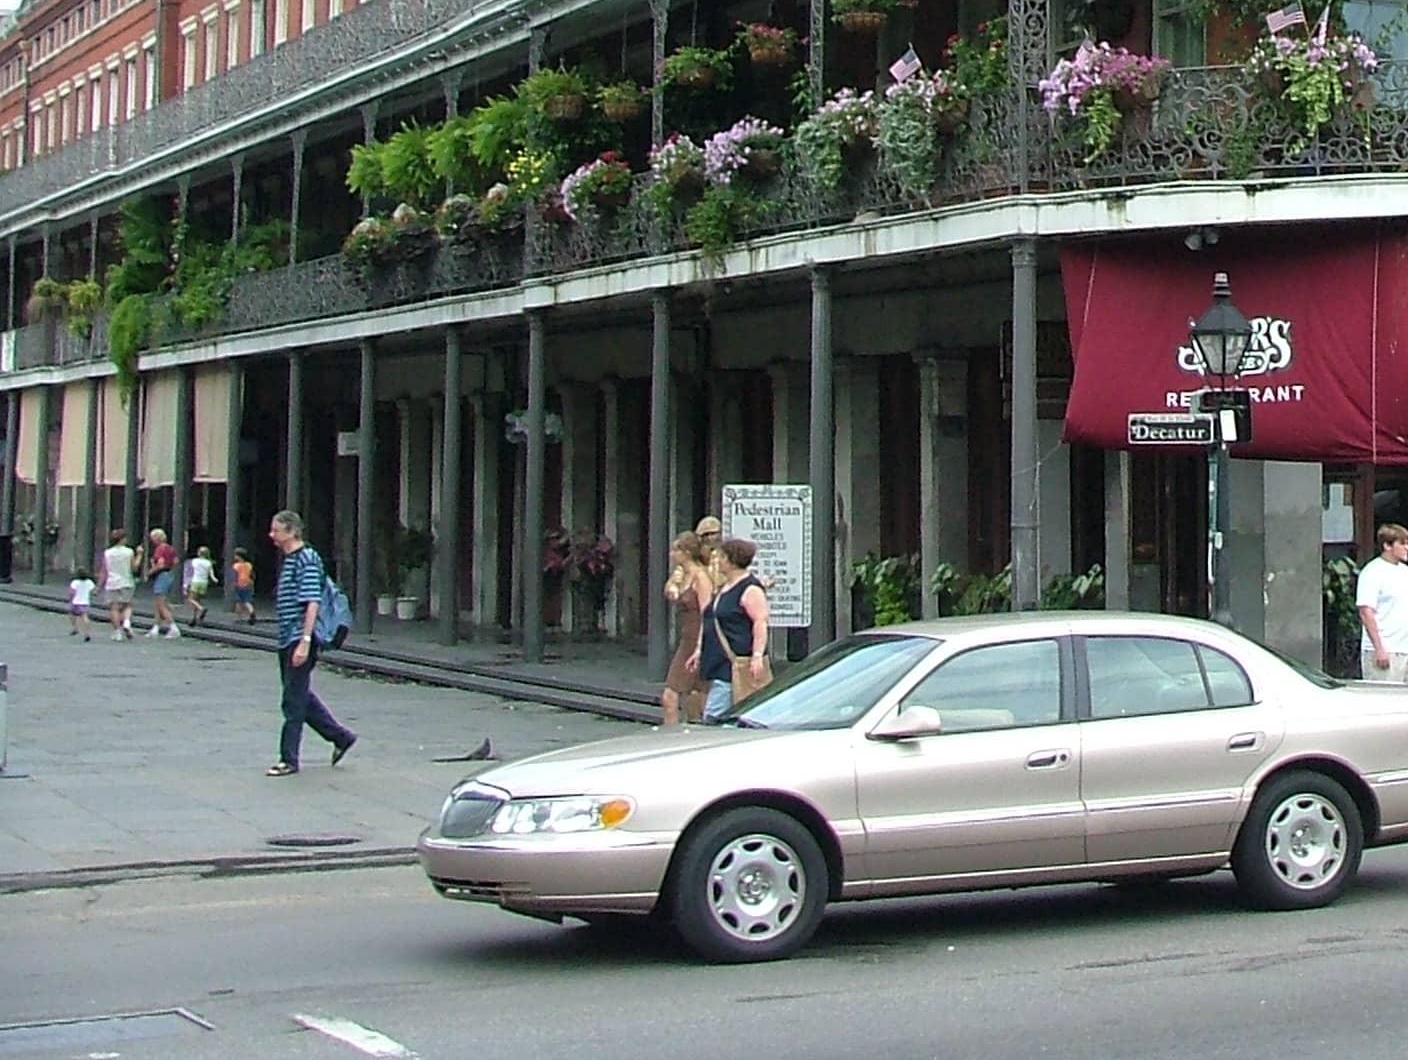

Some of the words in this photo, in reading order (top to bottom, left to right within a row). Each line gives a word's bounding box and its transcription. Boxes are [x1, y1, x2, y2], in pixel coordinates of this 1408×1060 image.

[1166, 386, 1304, 408] RERANT
[1131, 424, 1206, 440] Decatur
[735, 502, 800, 516] Pedestrian
[752, 518, 781, 530] Mall
